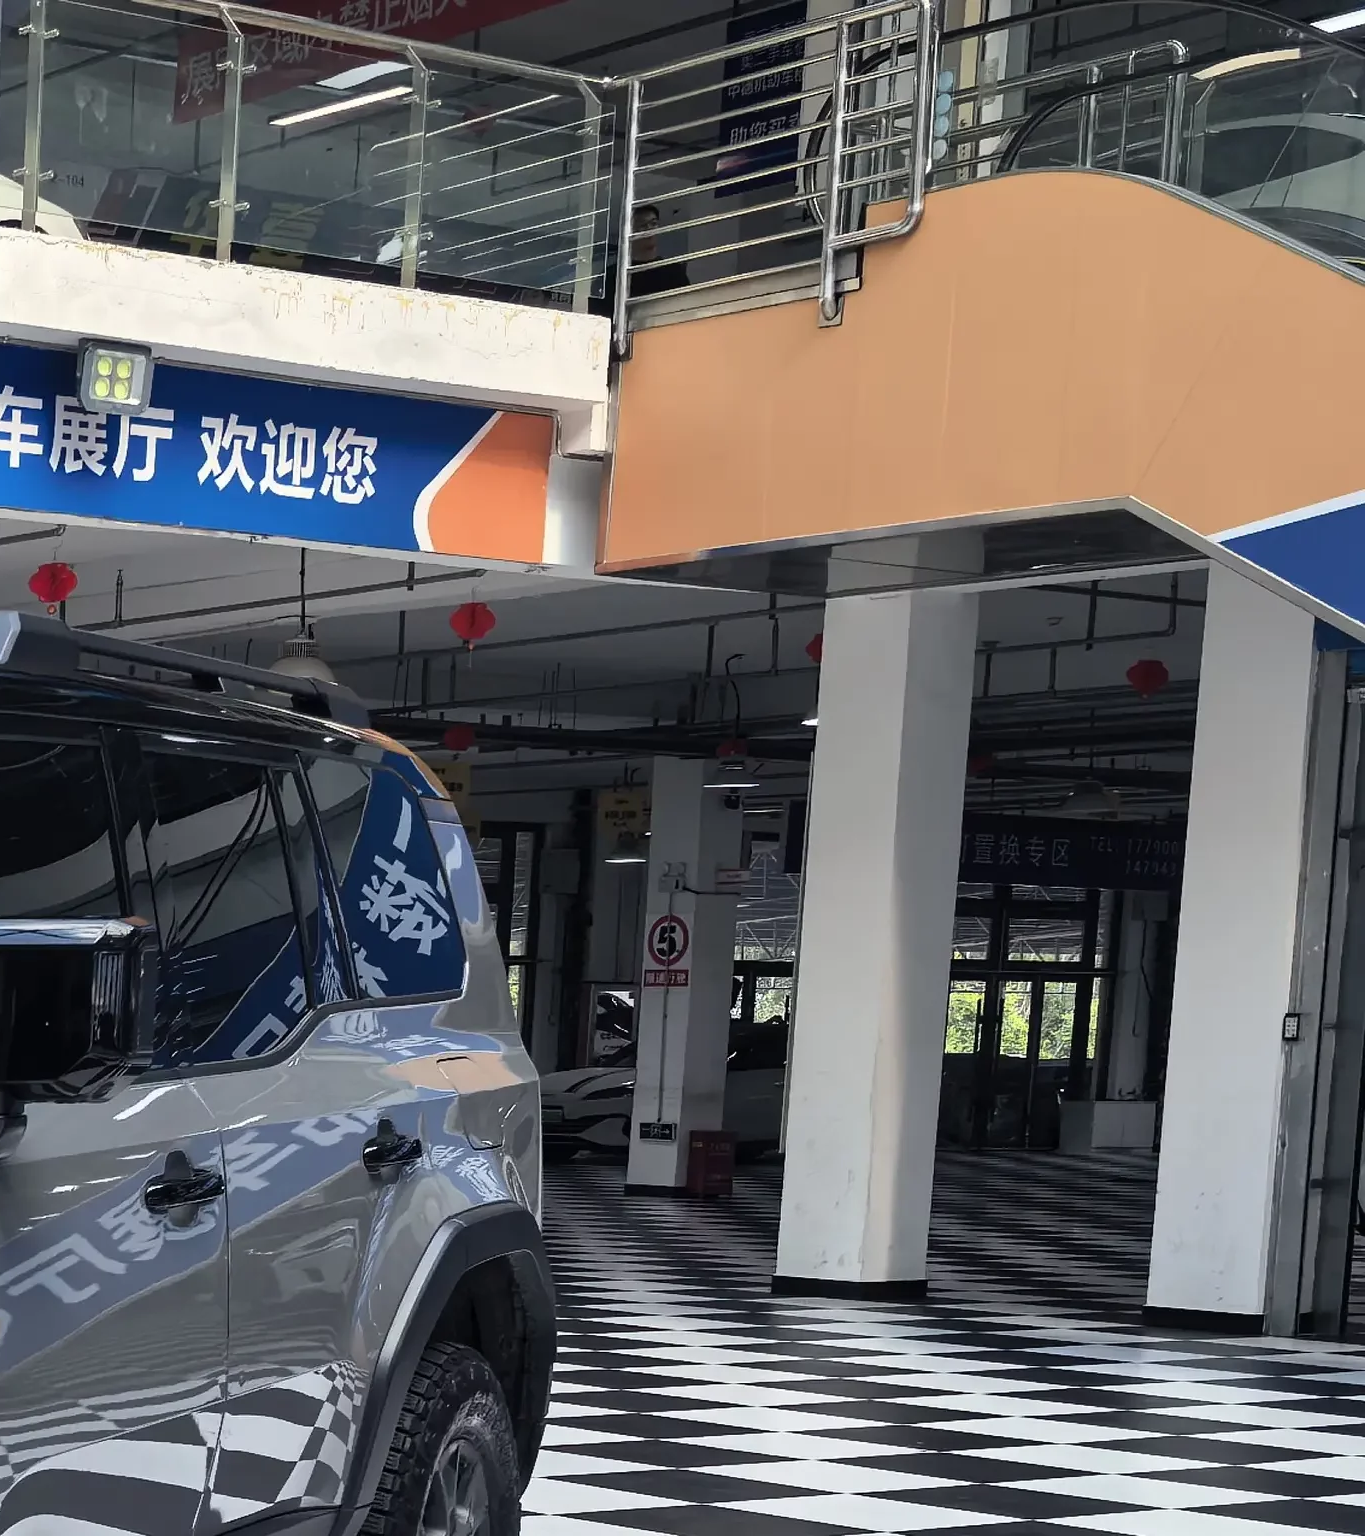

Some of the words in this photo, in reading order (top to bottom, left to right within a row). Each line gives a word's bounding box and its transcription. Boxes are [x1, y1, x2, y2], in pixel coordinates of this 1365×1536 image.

[197, 413, 378, 505] 欢迎您
[656, 924, 680, 958] 5
